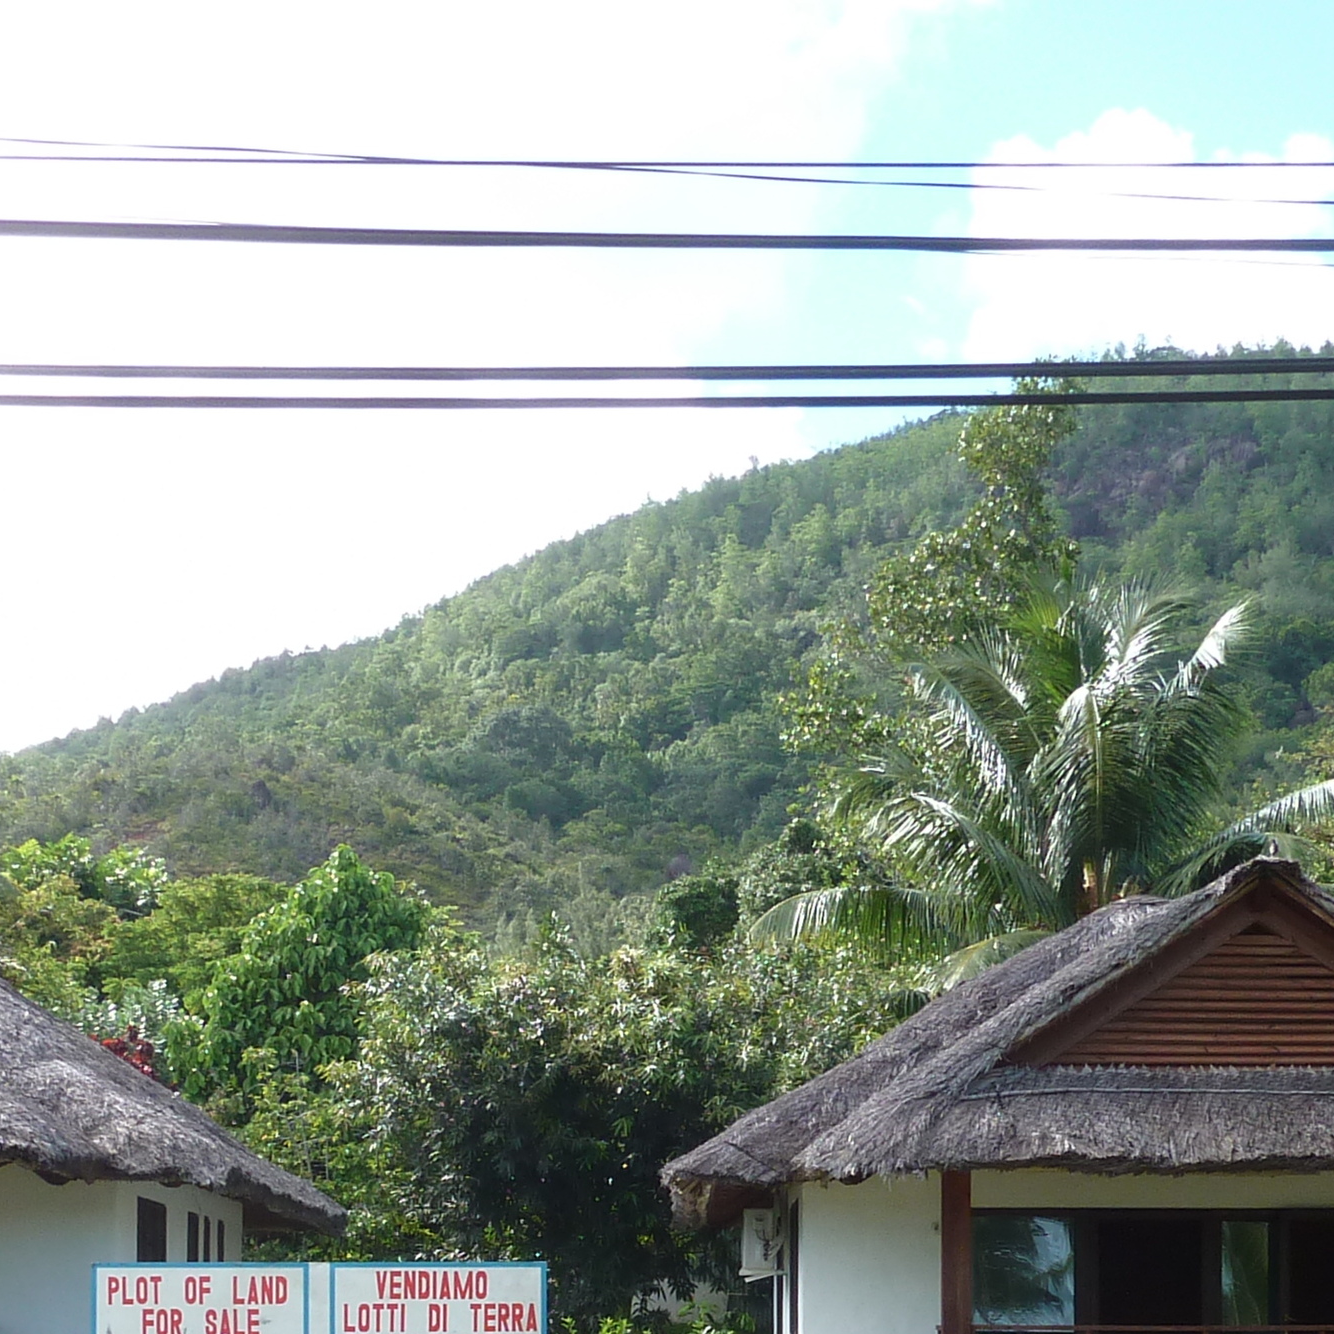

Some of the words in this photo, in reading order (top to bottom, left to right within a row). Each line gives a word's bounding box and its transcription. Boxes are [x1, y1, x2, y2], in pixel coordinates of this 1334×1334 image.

[107, 1276, 162, 1305] PLOT
[184, 1276, 211, 1305] OF
[232, 1275, 288, 1305] LAND
[375, 1270, 488, 1299] VENDIAMO
[343, 1303, 406, 1333] LOTTI
[428, 1303, 448, 1333] DI
[470, 1303, 538, 1332] TERRA
